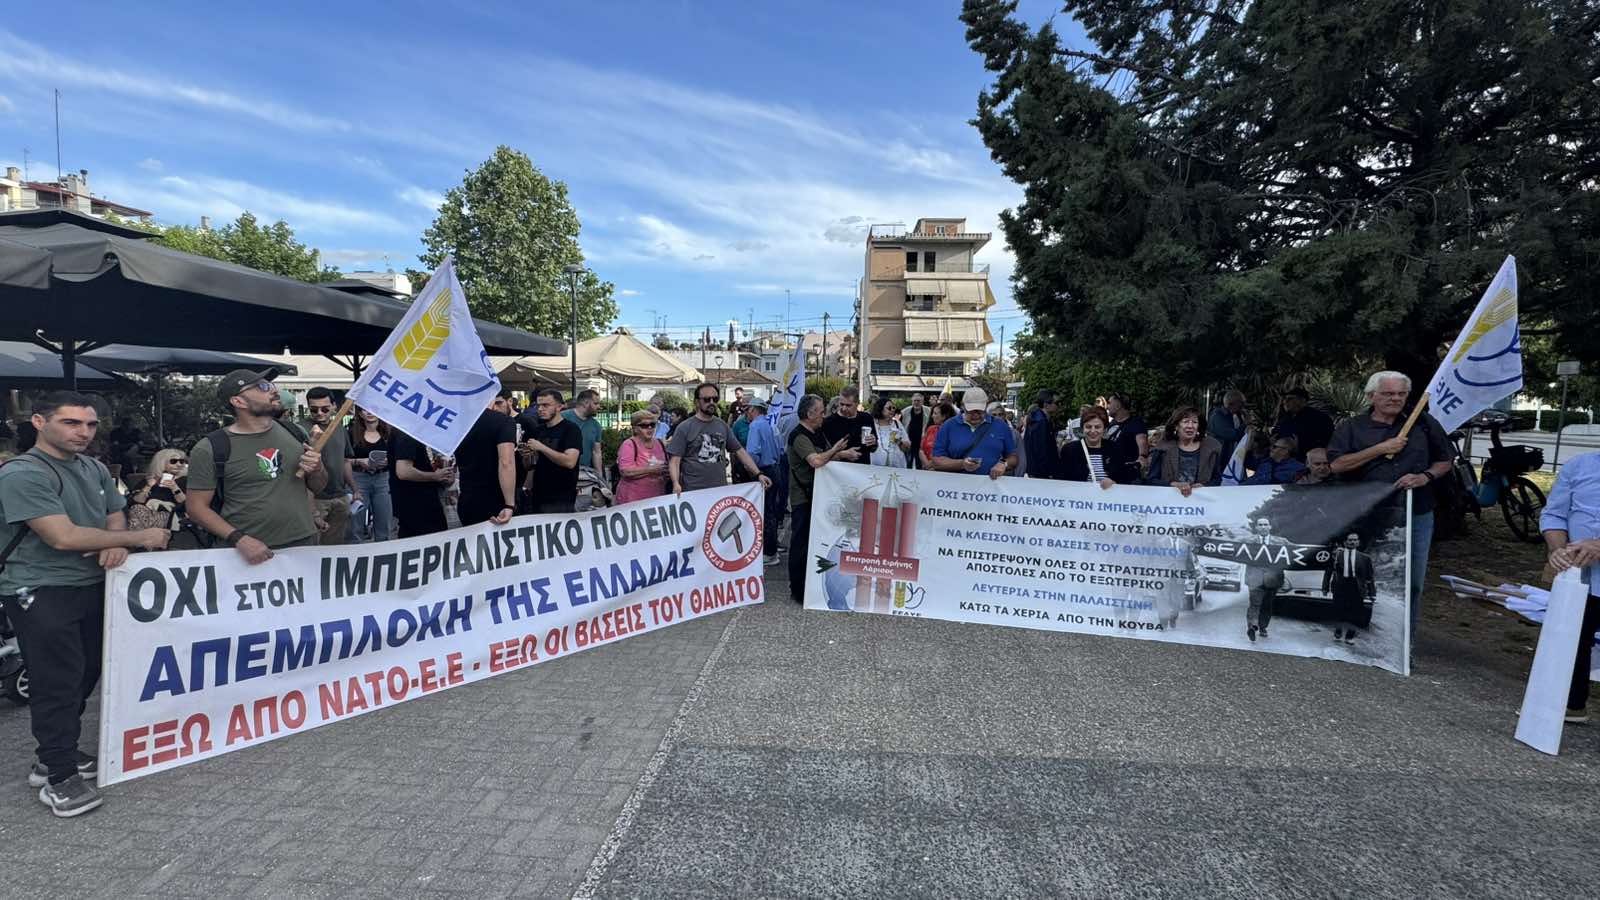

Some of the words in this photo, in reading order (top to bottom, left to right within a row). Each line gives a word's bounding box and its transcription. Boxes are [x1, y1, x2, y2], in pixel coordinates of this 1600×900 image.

[368, 370, 458, 430] ΕΕΔΥΕ
[937, 490, 958, 500] ΟΧΙ
[962, 492, 997, 502] ΣΤΟΥΣ
[1001, 495, 1065, 508] ΠΟΛΕΜΟΥΣ
[1068, 500, 1093, 510] ΤΩΝ
[1098, 502, 1205, 516] ΙΜΠΕΡΙΑΛΙΣΤΩΝ
[920, 508, 992, 520] ΑΠΕΜΠΛΟΚΗ
[996, 514, 1018, 524] ΤΗΣ
[1022, 517, 1076, 529] ΕΛΛΑΔΑΣ
[1080, 522, 1106, 532] ΑΠΟ
[1110, 524, 1144, 534] ΤΟΥΣ
[1147, 526, 1224, 538] ΠΟΛΕΜΟΥΣ
[946, 528, 962, 538] ΝΑ
[966, 531, 1025, 545] ΚΛΕΙΣΟΥΝ
[1029, 537, 1042, 546] ΟΙ
[1047, 539, 1090, 551] ΒΑΣΕΙΣ
[1094, 542, 1118, 552] ΤΟΥ
[1218, 543, 1308, 566] ΕΛΛΑΣ
[128, 566, 218, 622] ΟΧΙ
[234, 577, 304, 611] ΣΤΟΝ
[320, 520, 584, 600] ΙΜΠΕΡΙΑΛΙΣΤΙΚΟ
[591, 501, 696, 550] ΠΟΛΕΜΟ
[938, 548, 954, 556] ΝΑ
[958, 550, 1040, 566] ΕΠΙΣΤΡΕΨΟΥΝ
[1045, 559, 1076, 570] ΟΛΕΣ
[1080, 562, 1096, 572] ΟΙ
[1099, 564, 1198, 580] ΣΤΡΑΤΙΩΤΙΚΕΣ
[966, 562, 1036, 578] ΑΠΟΣΤΟΛΕΣ
[1040, 570, 1066, 580] ΑΠΟ
[1070, 574, 1086, 584] ΤΟ
[1090, 575, 1164, 590] ΕΞΩΤΕΡΙΚΟ
[972, 584, 1030, 598] ΛΕΥΤΕΡΙΑ
[1034, 590, 1066, 602] ΣΤΗΝ
[1070, 593, 1152, 610] ΠΑΛΑΙΣΤΙΝΗ
[139, 595, 472, 702] ΑΠΕΜΠΛΟΚΗ
[485, 576, 558, 624] ΤΗΣ
[564, 546, 696, 607] ΕΛΛΑΔΑΣ
[960, 602, 990, 612] ΚΑΤΩ
[994, 605, 1009, 616] ΤΑ
[1013, 608, 1050, 620] ΧΕΡΙΑ
[1057, 613, 1084, 624] ΑΠΟ
[1088, 616, 1114, 627] ΤΗΝ
[1118, 620, 1164, 631] ΚΟΥΒΑ
[122, 713, 212, 772] ΕΞΩ
[226, 690, 306, 746] ΑΠΟ
[489, 634, 538, 672] ΕΞΩ
[544, 626, 568, 656] ΟΙ
[575, 603, 646, 647] ΒΑΣΕΙΣ
[648, 592, 684, 624] ΤΟΥ
